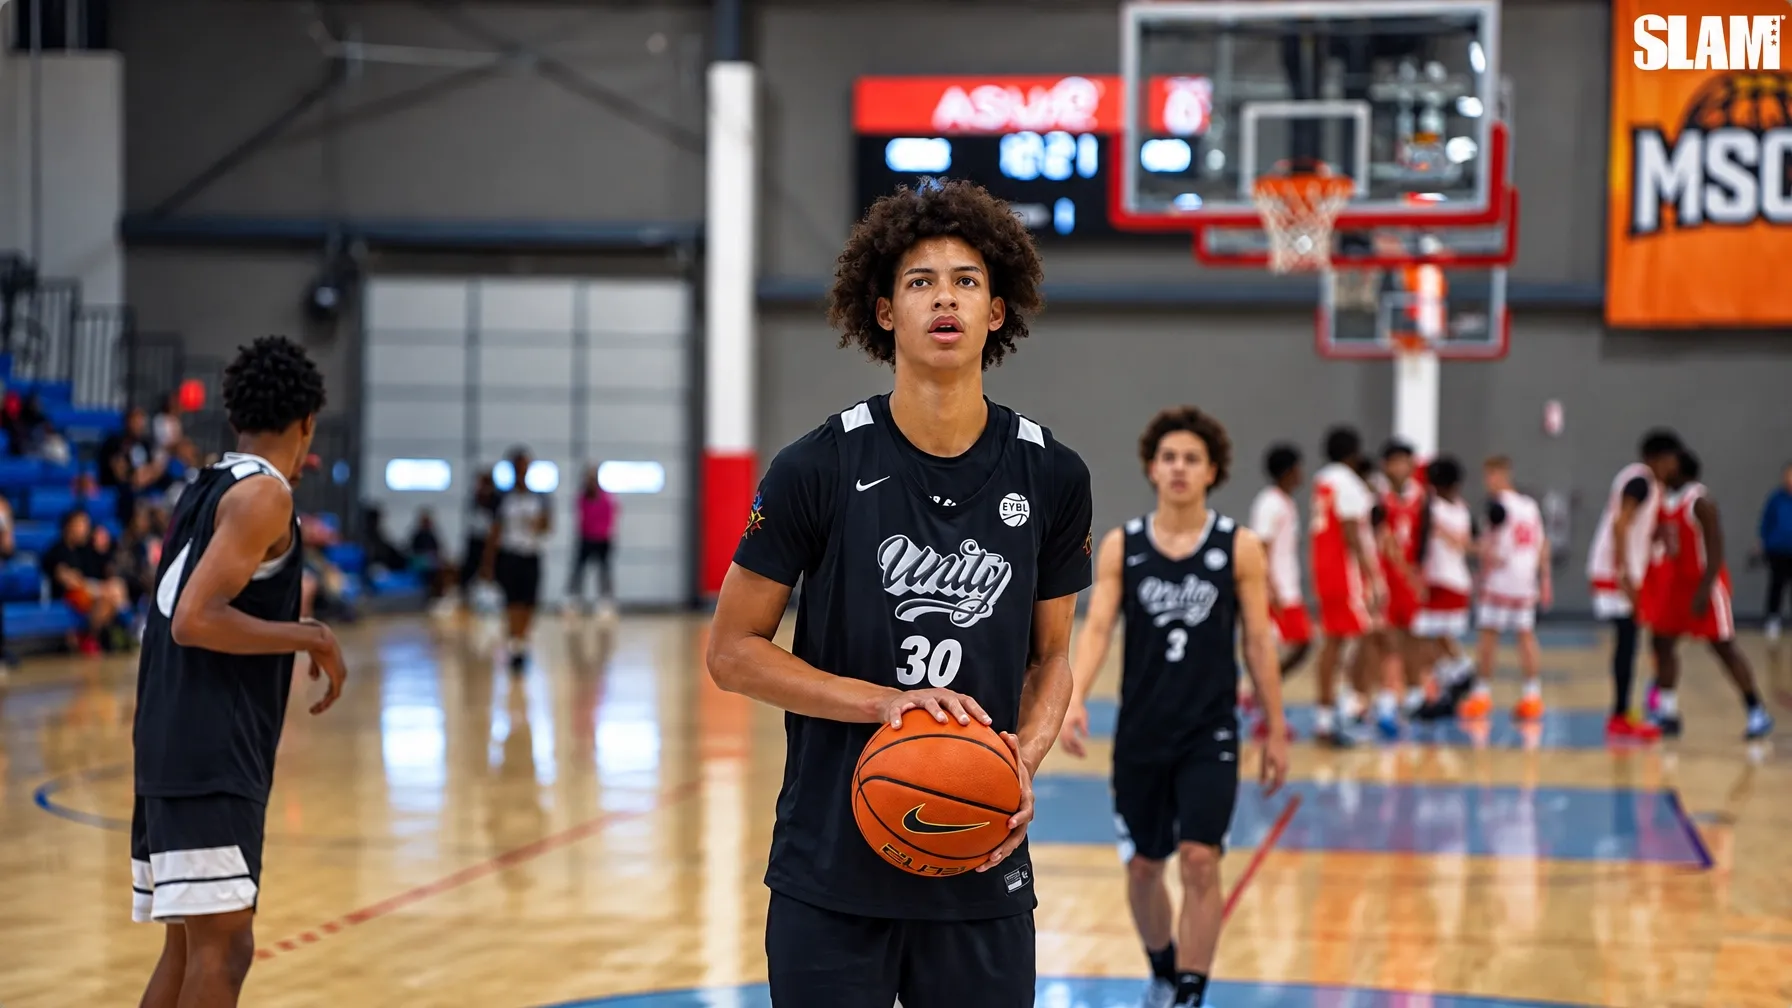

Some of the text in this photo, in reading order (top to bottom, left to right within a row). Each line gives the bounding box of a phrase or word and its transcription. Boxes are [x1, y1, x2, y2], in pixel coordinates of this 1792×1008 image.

[1002, 502, 1028, 512] EYBL
[877, 534, 1012, 628] Unity
[896, 635, 962, 688] 30
[1165, 628, 1188, 662] 3
